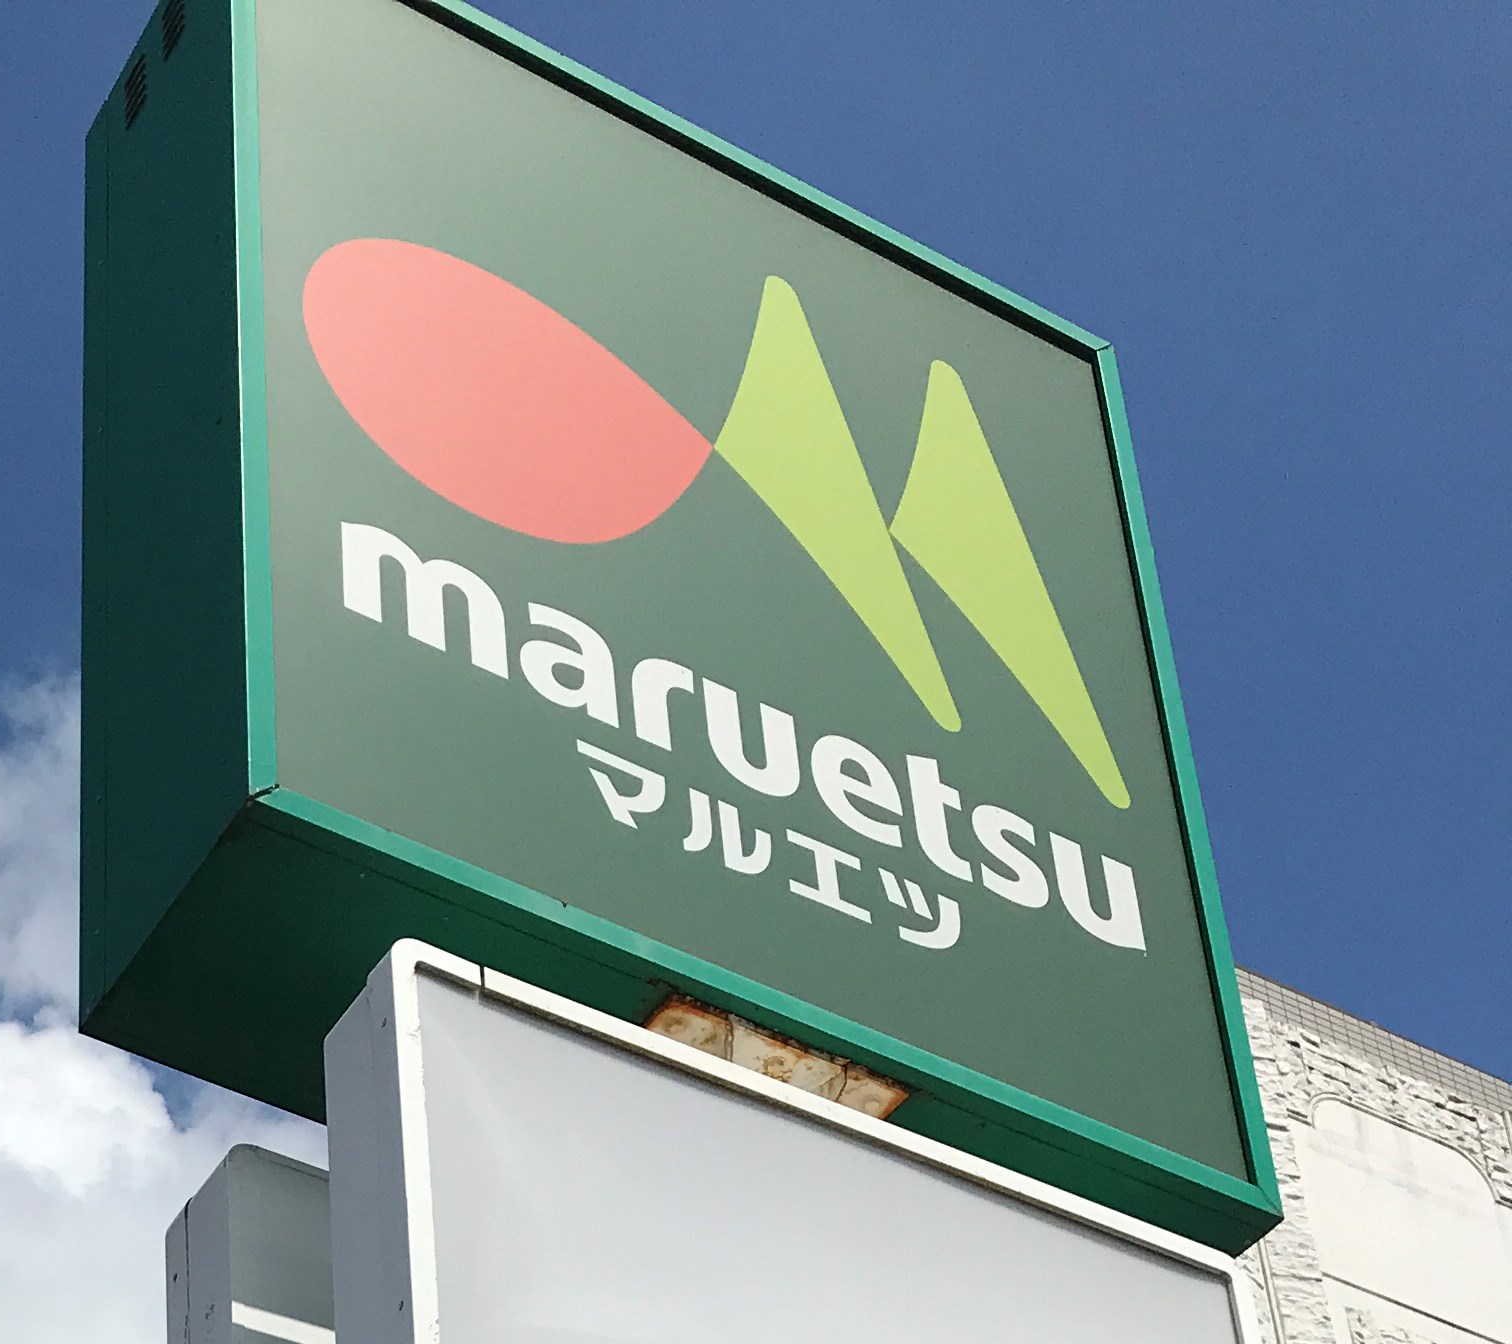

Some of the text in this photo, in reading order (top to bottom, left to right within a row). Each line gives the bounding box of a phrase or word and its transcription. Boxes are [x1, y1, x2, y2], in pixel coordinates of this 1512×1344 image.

[342, 521, 1147, 951] maruetsu
[575, 738, 962, 950] マルエツ
